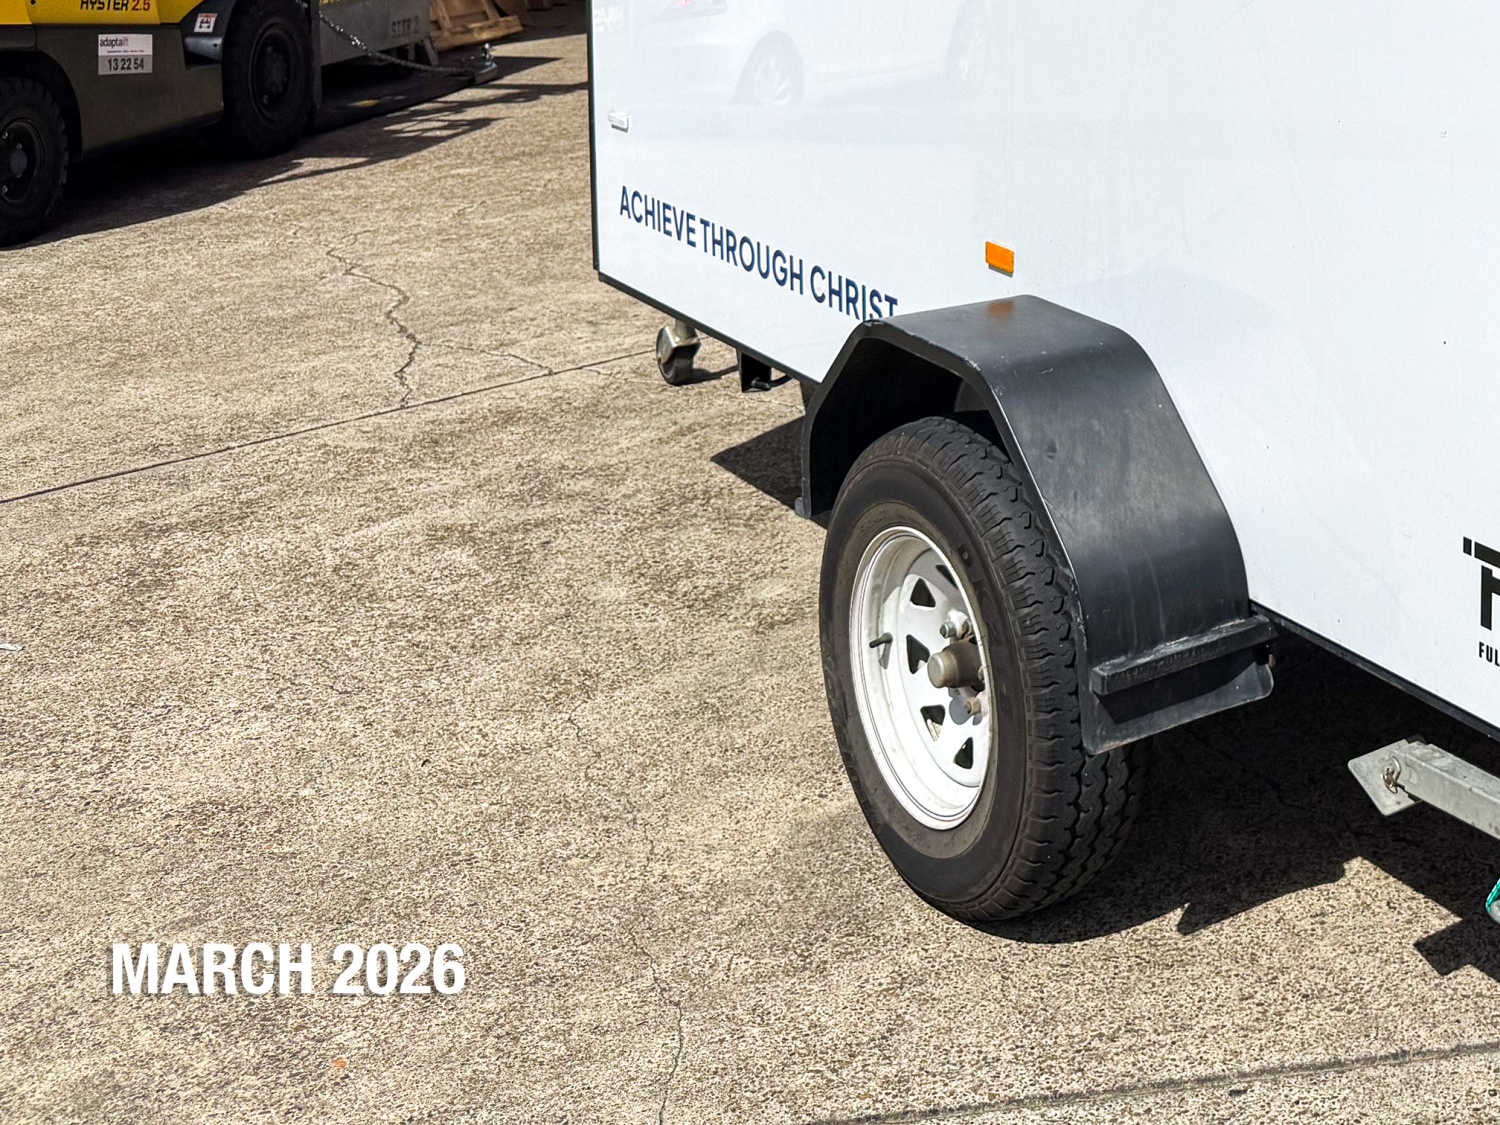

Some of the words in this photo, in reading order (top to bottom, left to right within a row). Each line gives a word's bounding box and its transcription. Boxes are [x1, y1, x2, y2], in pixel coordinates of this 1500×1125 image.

[108, 59, 119, 71] 13
[120, 58, 132, 70] 22
[134, 57, 145, 70] 54
[620, 185, 696, 248] ACHIEVE
[700, 218, 804, 296] THROUGH
[810, 264, 898, 322] CHRIST
